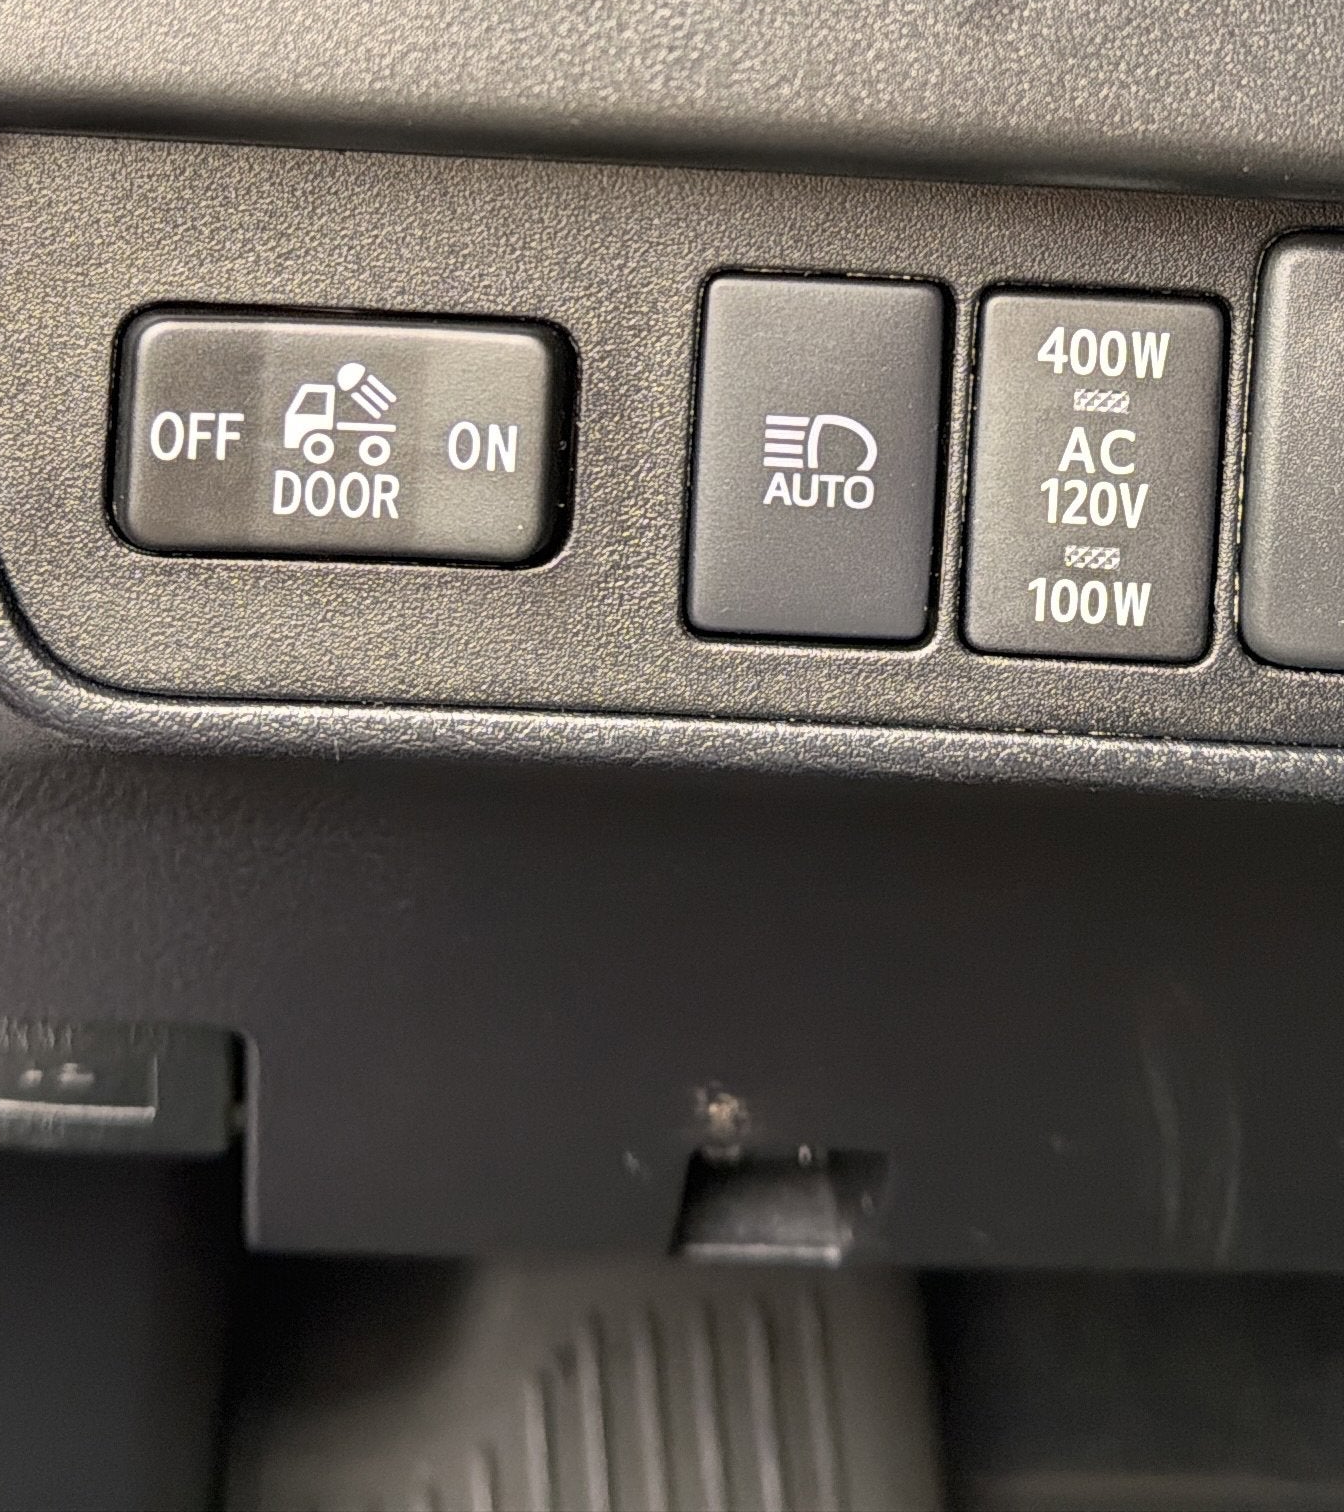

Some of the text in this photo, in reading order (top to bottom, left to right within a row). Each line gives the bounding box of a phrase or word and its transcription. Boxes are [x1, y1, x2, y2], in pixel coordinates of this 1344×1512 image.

[1037, 327, 1171, 379] 400W
[150, 411, 245, 461] OFF
[448, 421, 518, 473] ON
[1058, 426, 1136, 475] AC
[272, 470, 399, 519] DOOR
[763, 474, 875, 510] AUTO
[1040, 478, 1149, 529] 120V
[1028, 577, 1152, 627] 100W
